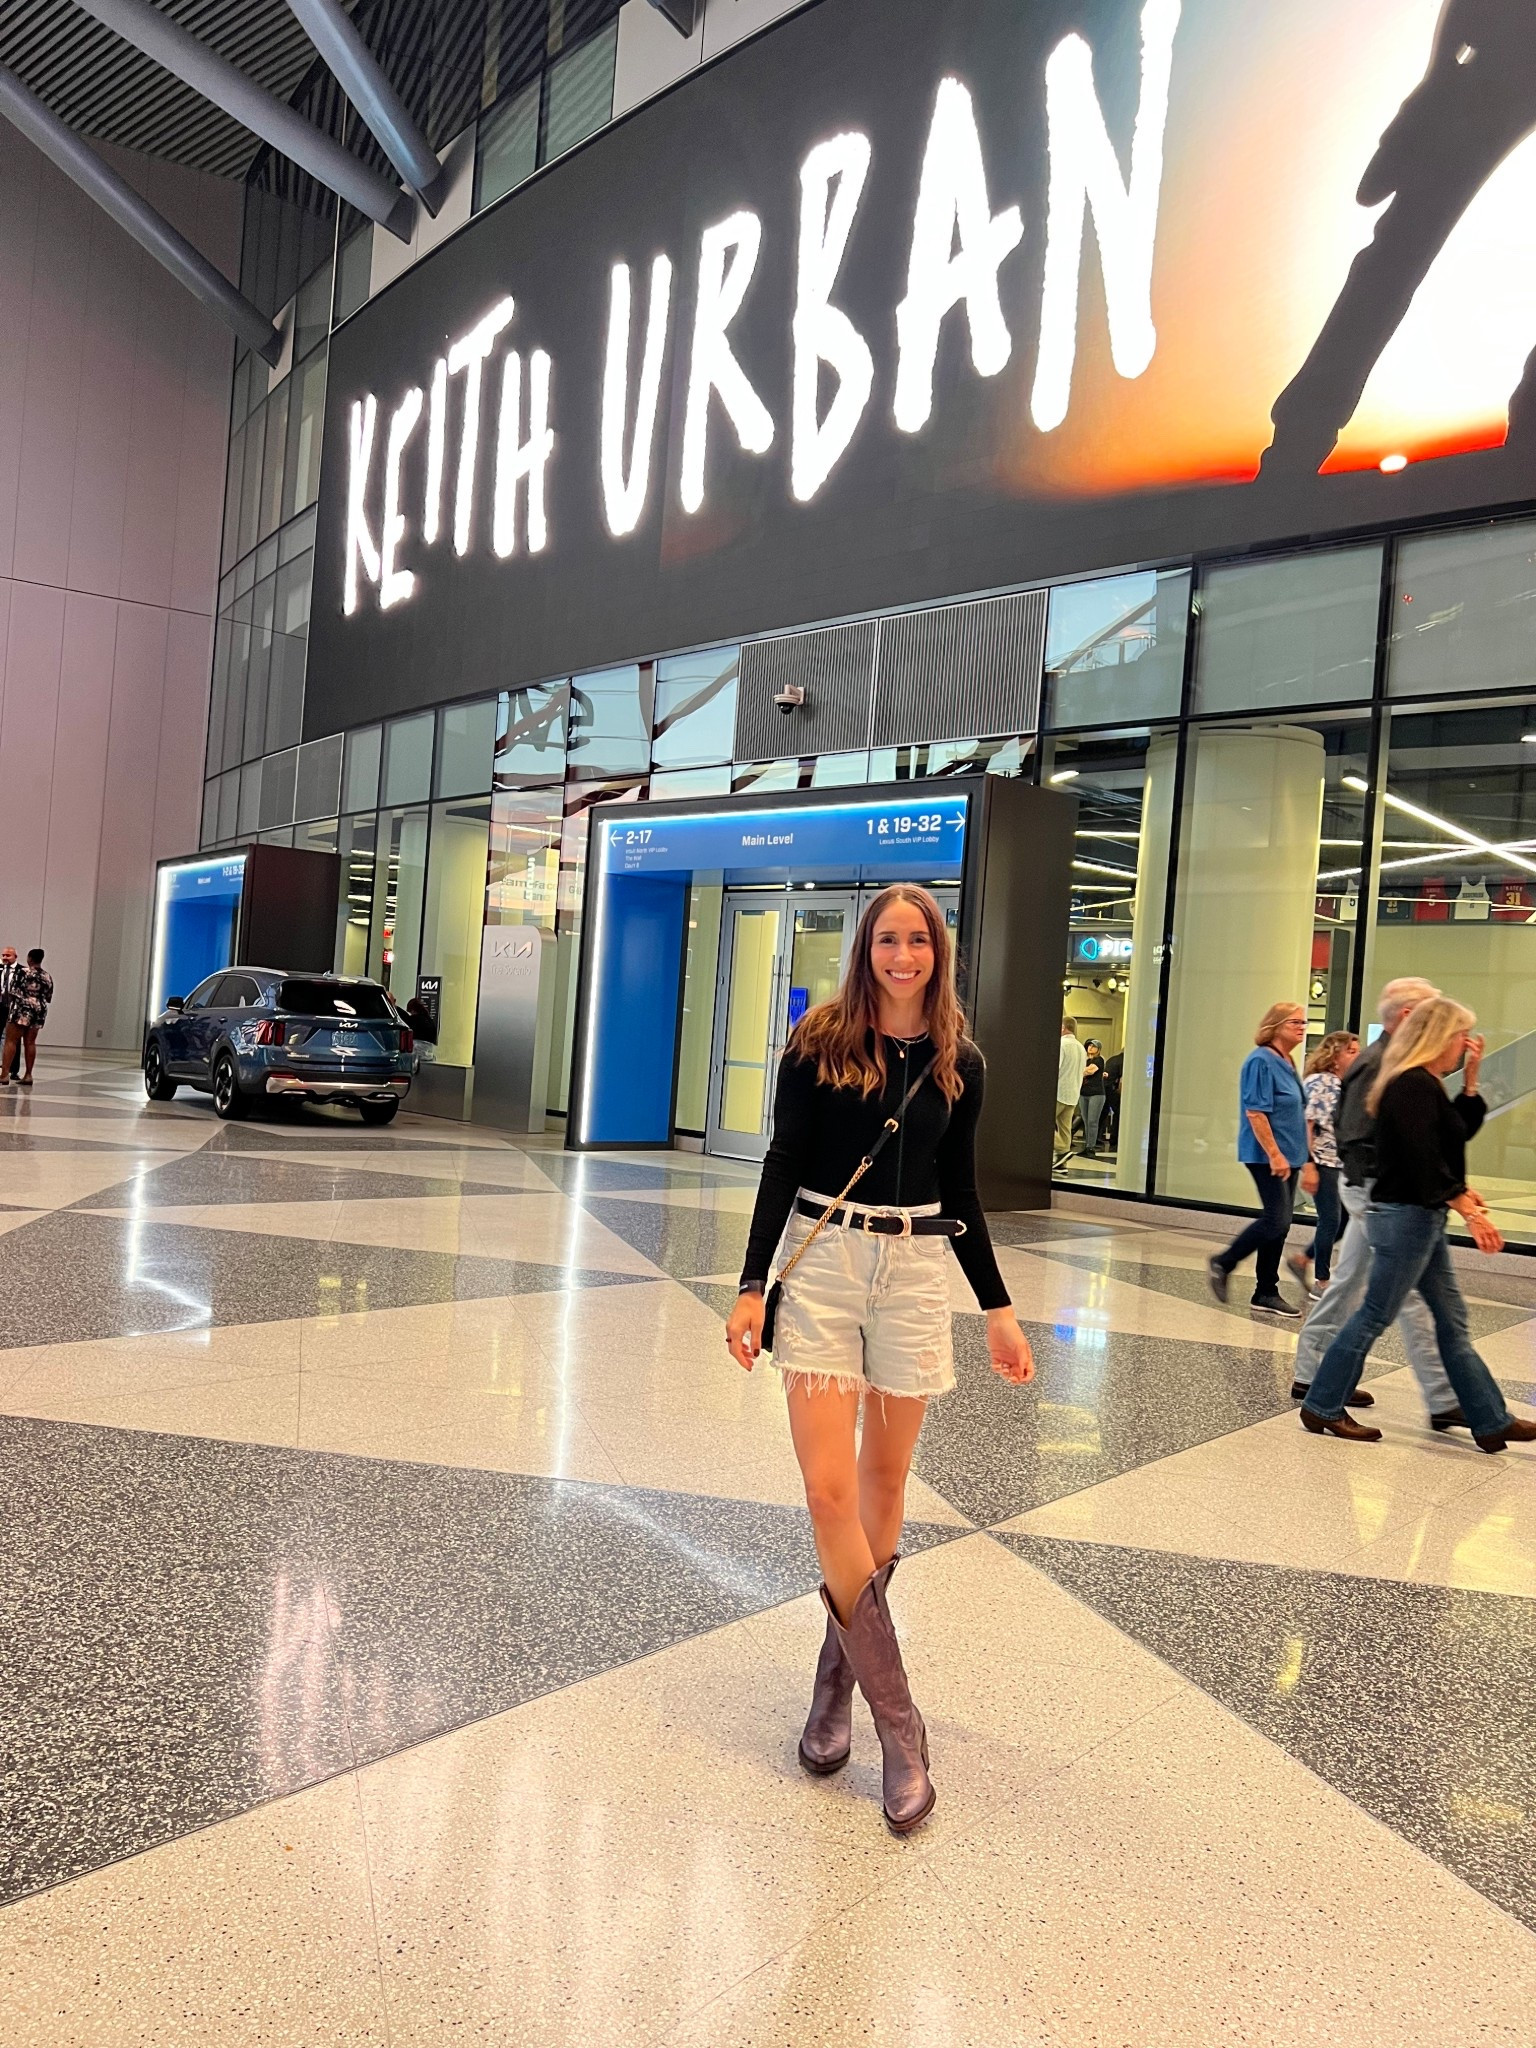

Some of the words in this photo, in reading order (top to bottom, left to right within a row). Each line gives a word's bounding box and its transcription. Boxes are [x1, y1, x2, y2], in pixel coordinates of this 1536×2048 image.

[343, 295, 555, 616] KEITH
[602, 0, 1181, 536] URBAN
[867, 820, 873, 835] 1
[878, 818, 889, 834] &
[893, 814, 942, 833] 19-32
[626, 830, 652, 845] 2-17
[742, 834, 765, 846] Main
[767, 832, 793, 845] Level
[922, 835, 939, 843] Lobby
[1505, 891, 1521, 906] 31
[489, 940, 534, 958] KIA
[421, 980, 439, 990] KIA
